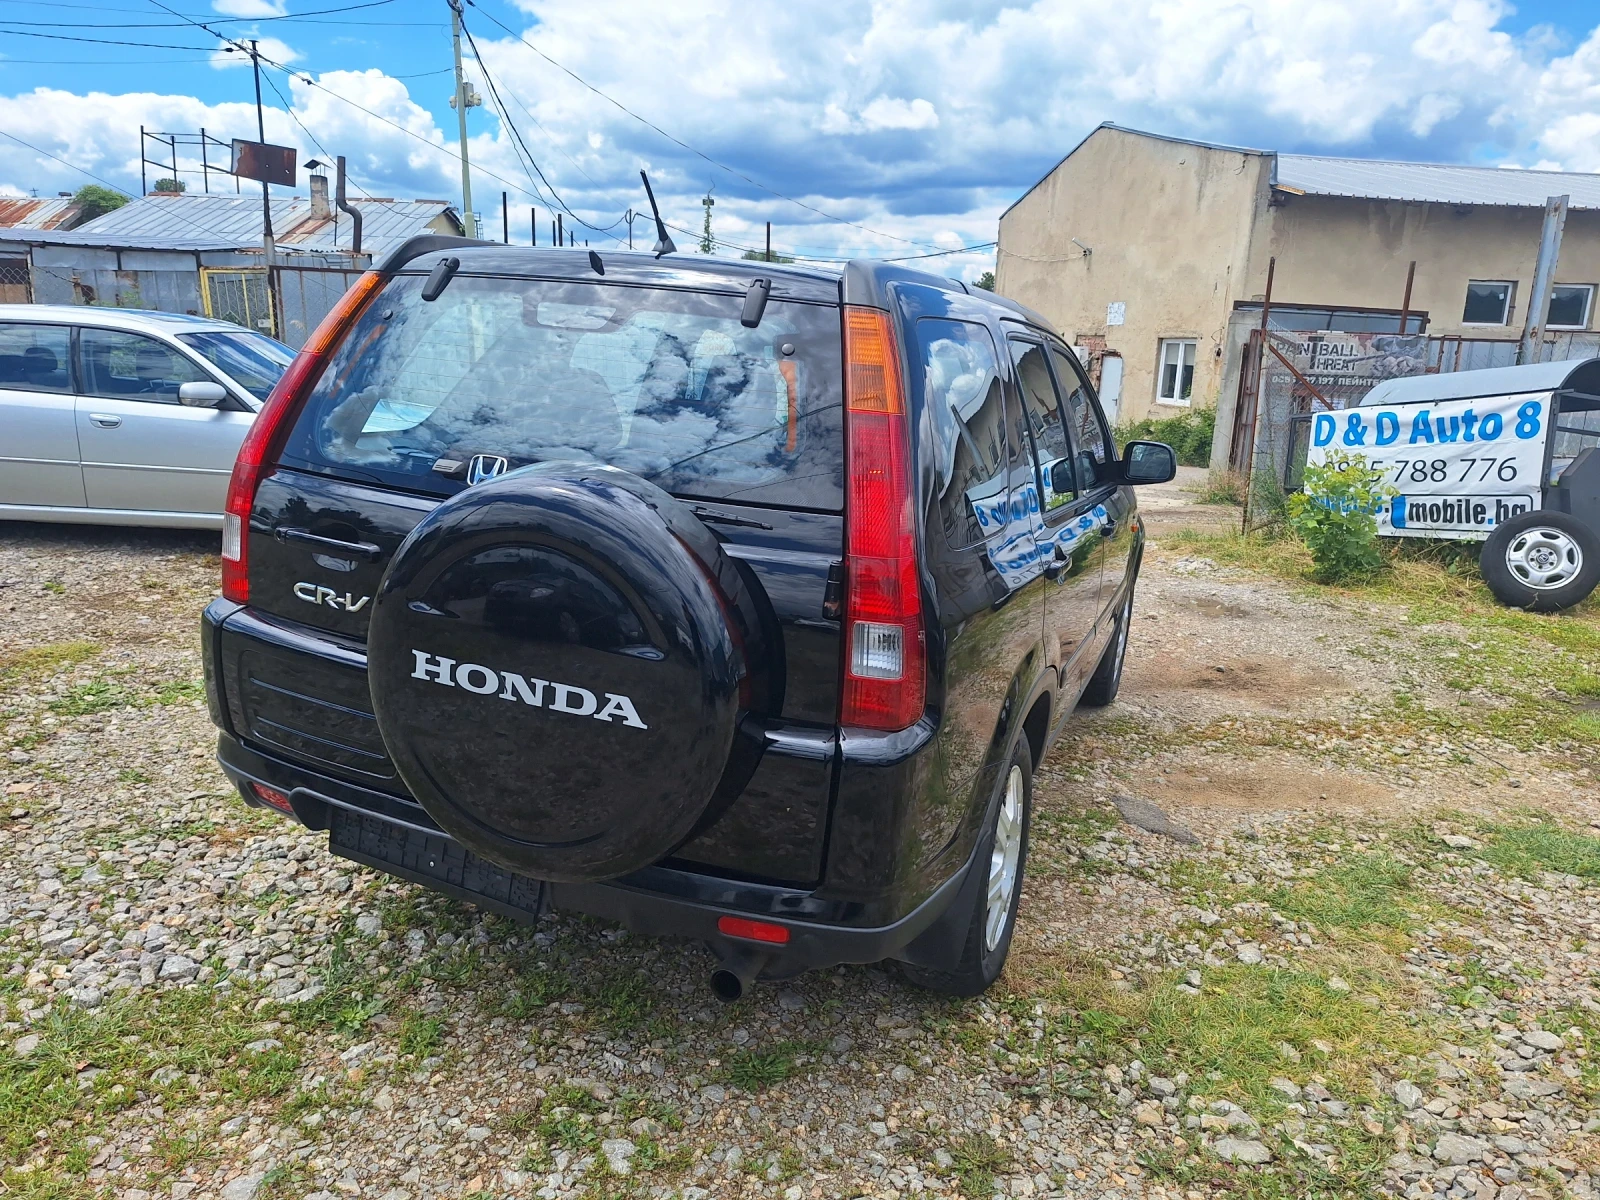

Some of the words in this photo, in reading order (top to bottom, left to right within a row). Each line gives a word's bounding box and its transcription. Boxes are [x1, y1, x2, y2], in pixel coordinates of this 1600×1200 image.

[1275, 336, 1358, 357] PANTBALL
[1318, 377, 1334, 385] 197
[1338, 376, 1385, 386] ПЕЙНТБ
[1314, 414, 1336, 446] D
[1343, 413, 1368, 446] &
[1375, 411, 1400, 445] D
[1409, 408, 1503, 444] Auto
[1515, 401, 1542, 439] 8
[1394, 459, 1447, 482] 788
[1458, 457, 1518, 482] 776
[293, 582, 371, 612] CR-V
[411, 649, 648, 729] HONDA
